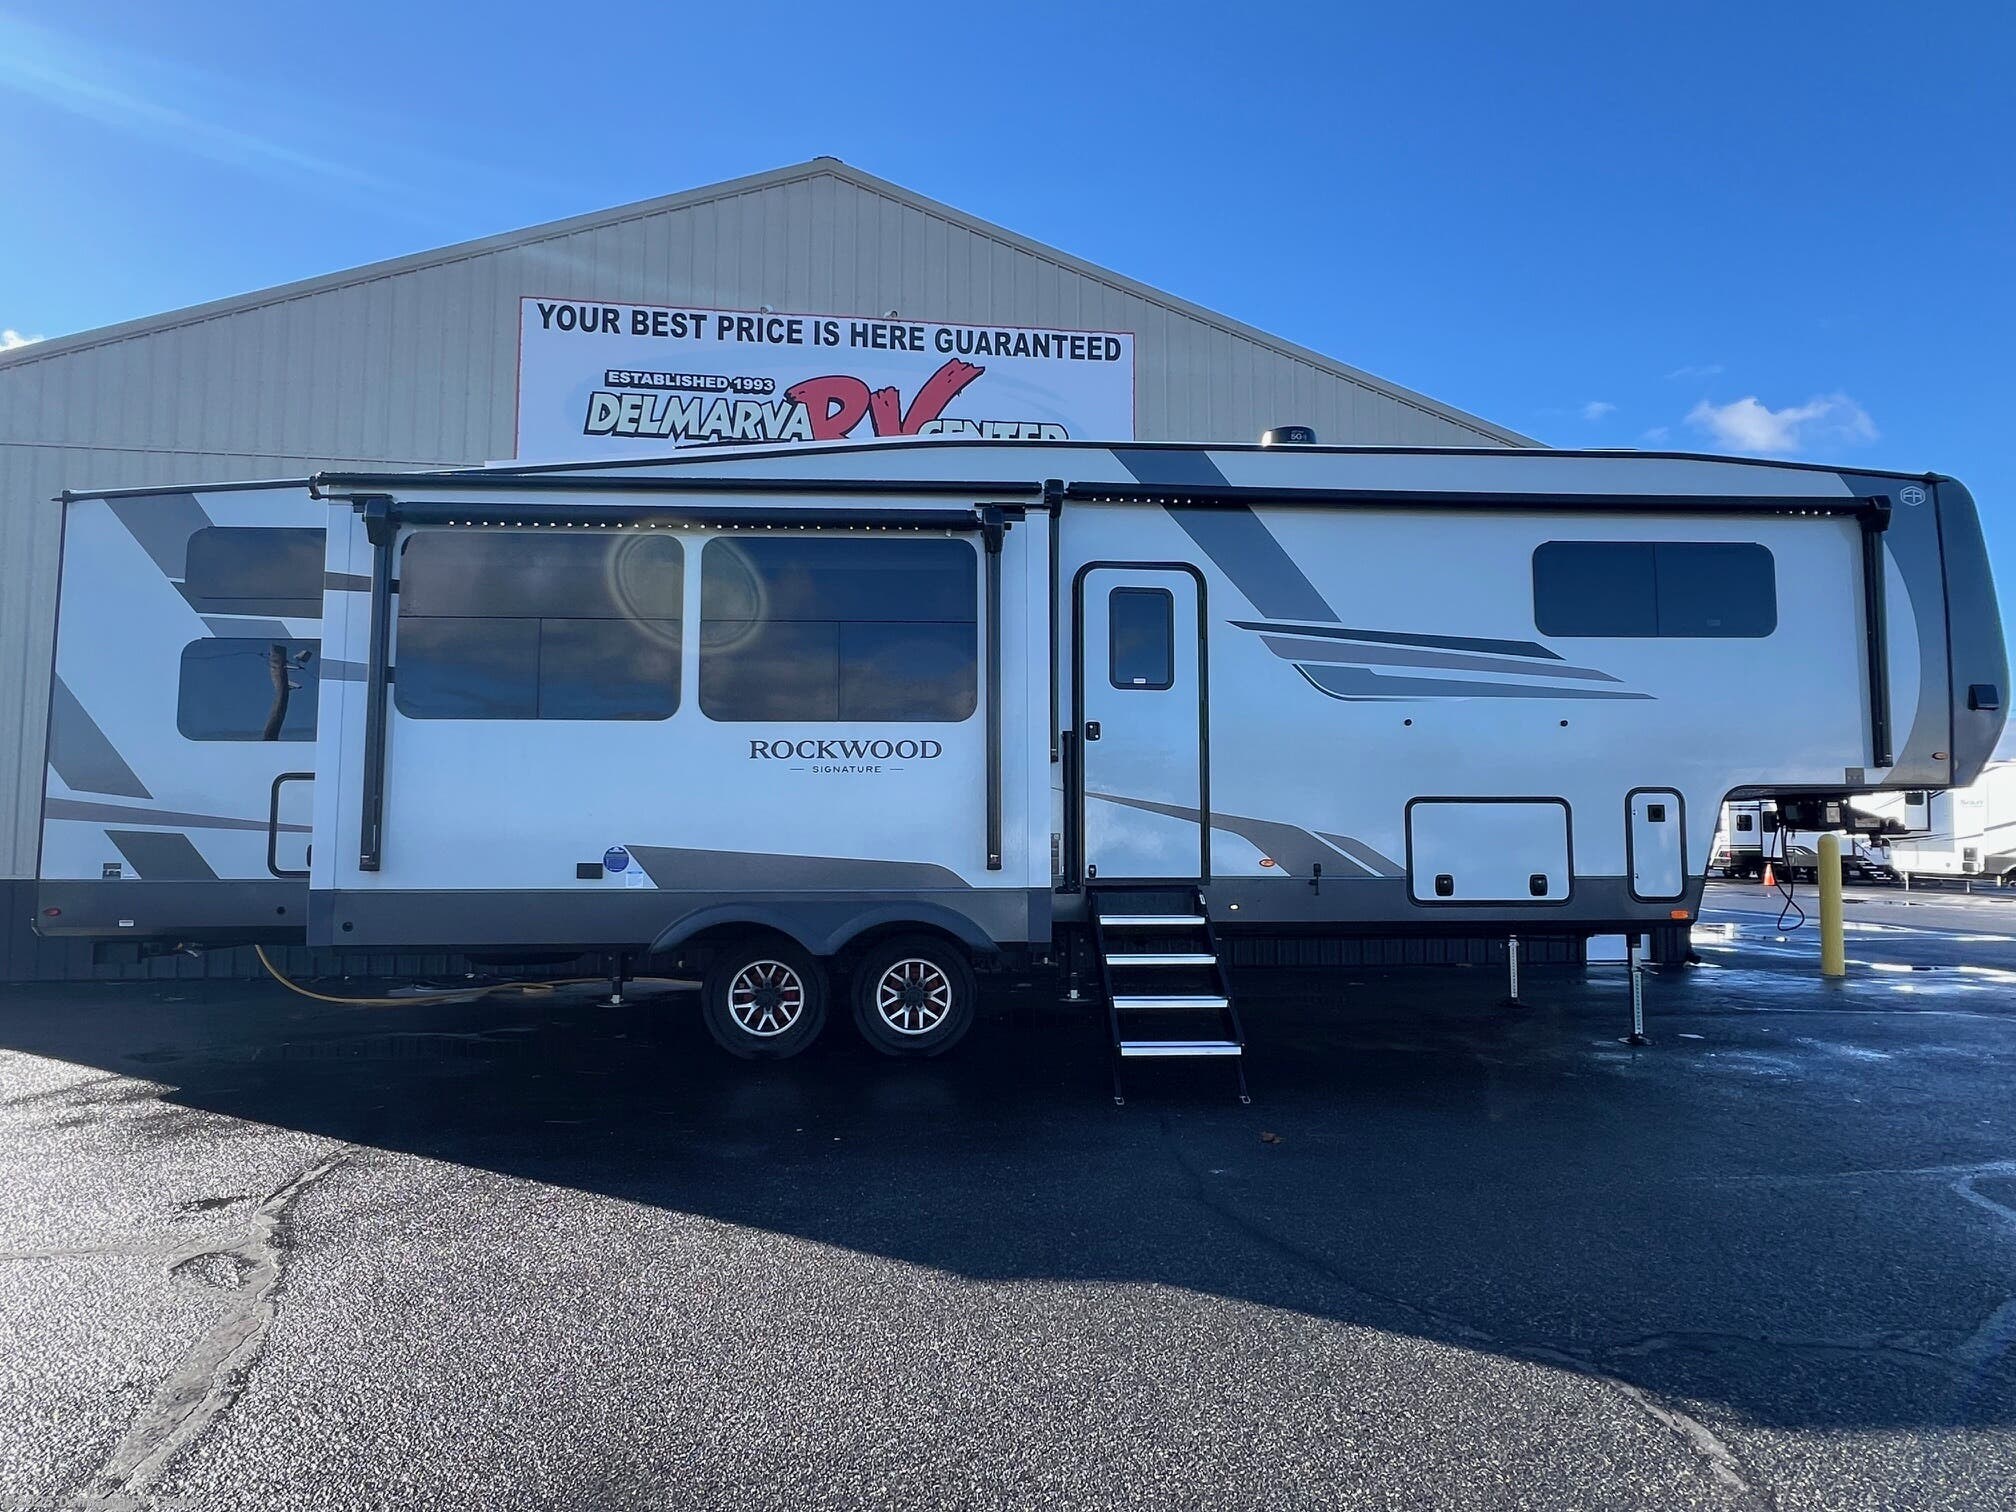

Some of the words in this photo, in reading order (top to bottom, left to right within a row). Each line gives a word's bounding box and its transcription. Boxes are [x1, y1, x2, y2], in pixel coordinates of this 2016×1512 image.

[536, 303, 621, 334] YOUR
[631, 309, 707, 339] BEST
[717, 315, 803, 345] PRICE
[813, 320, 840, 346] IS
[850, 322, 925, 351] HERE
[934, 328, 1122, 362] GUARANTEED
[606, 370, 728, 391] ESTABLISHED
[732, 376, 776, 393] 1993
[585, 392, 815, 440] DELMARVA
[785, 358, 985, 440] RV
[749, 740, 943, 759] ROCKWOOD
[812, 765, 882, 774] SIGNATURE
